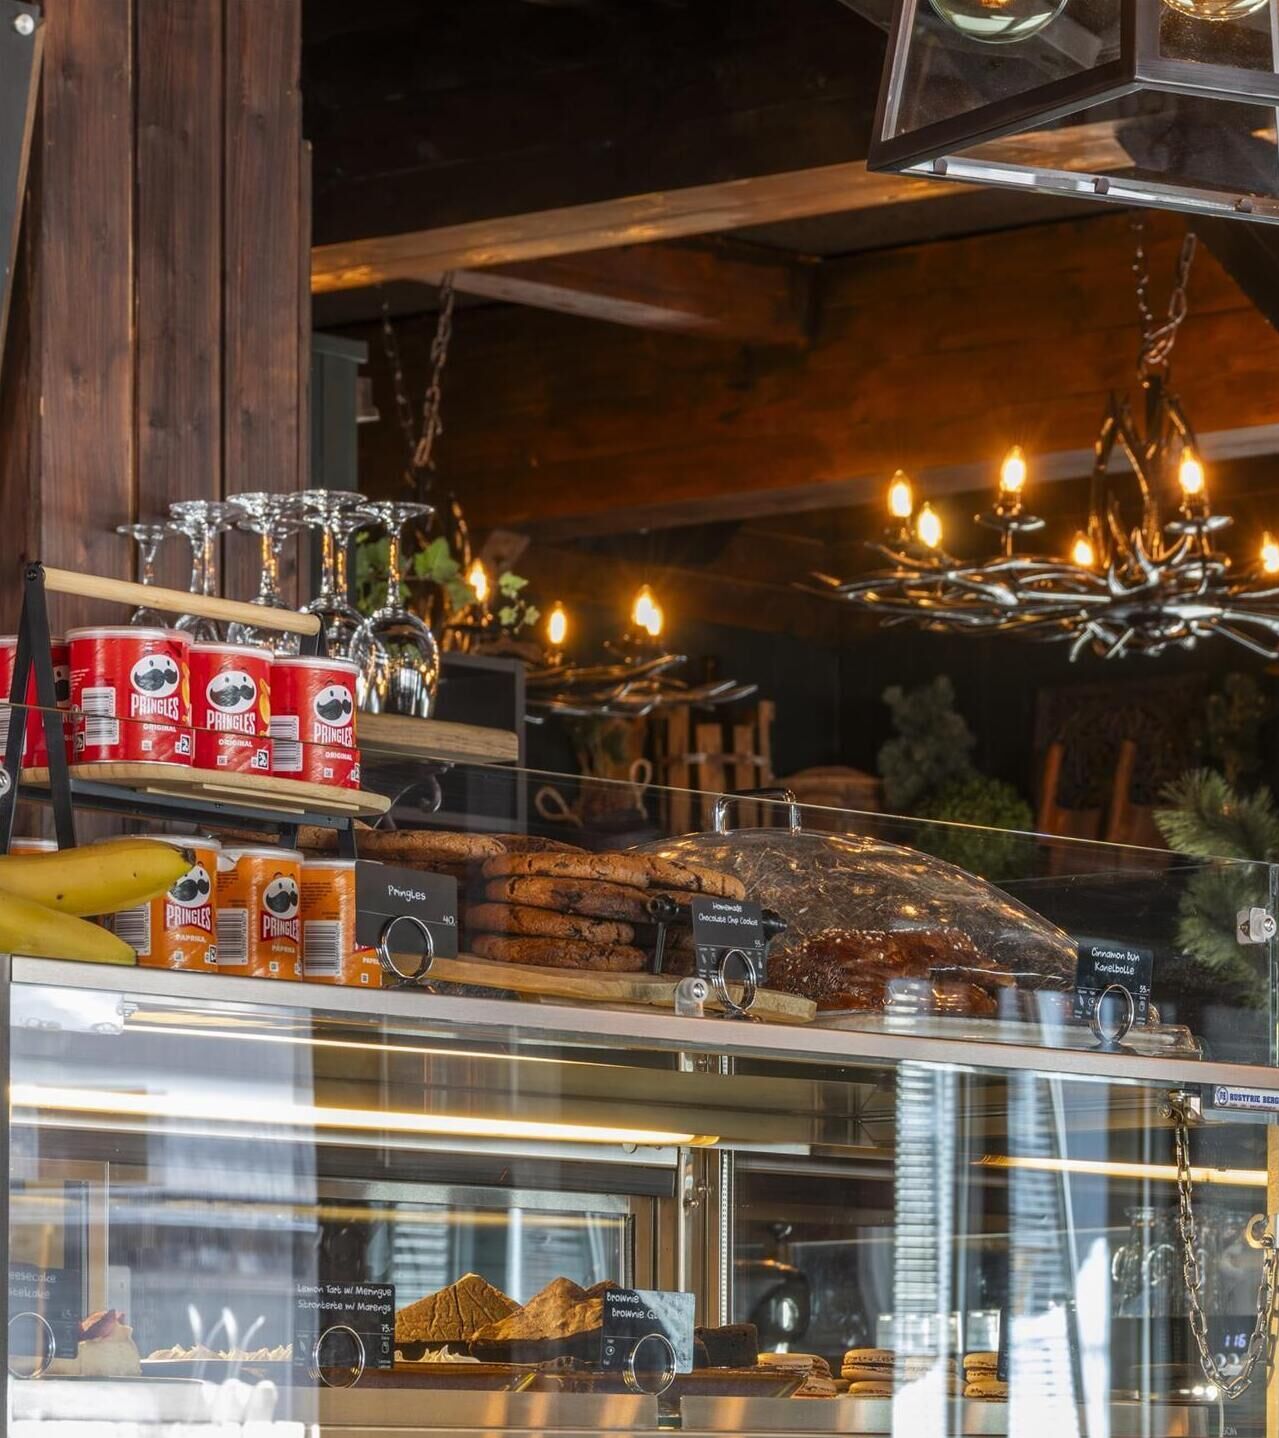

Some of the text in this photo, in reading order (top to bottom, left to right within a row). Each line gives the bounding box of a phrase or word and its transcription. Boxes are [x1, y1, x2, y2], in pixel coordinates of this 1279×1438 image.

[130, 693, 179, 721] PRINGLES
[143, 723, 177, 733] ORIGINAL
[206, 709, 256, 735] PRINGLES
[313, 722, 353, 748] PRINGLES
[218, 738, 253, 748] ORIGINAL
[325, 751, 353, 761] ORIGINAL
[387, 884, 426, 901] Pringles
[712, 902, 743, 913] Homemade
[166, 903, 211, 932] PRINGLES
[698, 913, 727, 924] Chocolate
[1091, 946, 1140, 962] Cinnamon Bun
[1094, 961, 1135, 975] Kanelbolle
[297, 1284, 393, 1299] Lemon Tart w/ Meringue
[357, 1303, 392, 1315] Marengs
